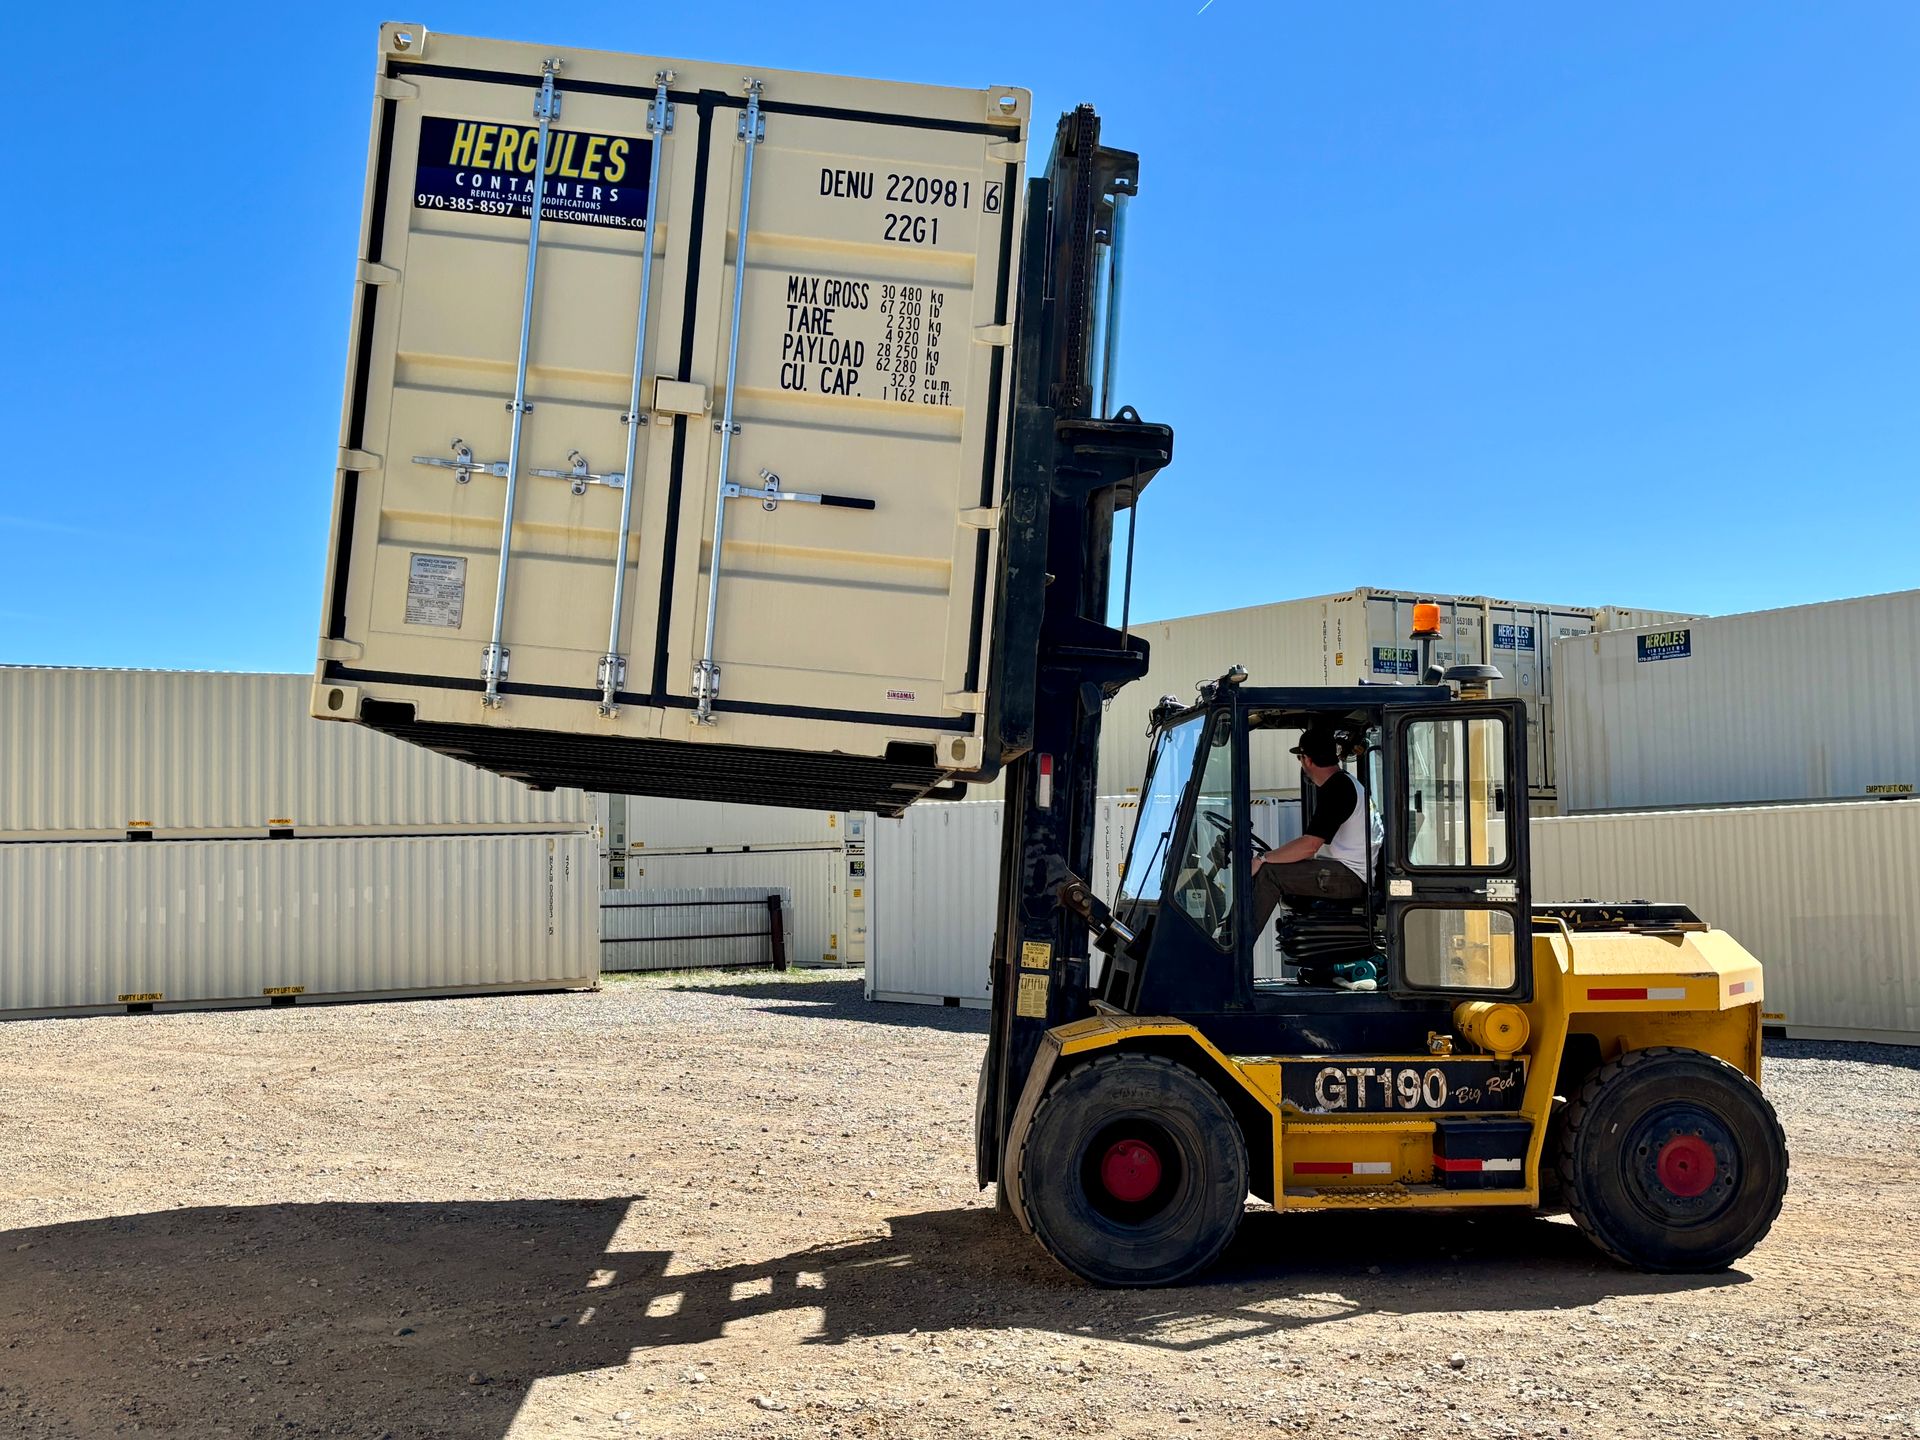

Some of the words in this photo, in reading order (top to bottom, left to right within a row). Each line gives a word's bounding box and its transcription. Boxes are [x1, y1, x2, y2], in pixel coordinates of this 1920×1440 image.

[449, 122, 629, 183] HERCULES
[455, 172, 619, 202] CONTAINERS
[470, 189, 501, 199] RENTAL
[507, 193, 532, 203] SALES
[820, 168, 874, 200] DENU
[886, 174, 970, 209] 220981
[985, 184, 999, 211] 6
[418, 193, 514, 215] 970-385-8597
[522, 205, 648, 228] HCULESCONTAINERS.CO
[884, 213, 939, 244] 22G1
[787, 275, 820, 305] MAX
[823, 279, 870, 310] GROSS
[881, 285, 896, 300] 30
[900, 287, 922, 302] 480
[930, 289, 944, 308] kg
[786, 304, 836, 336] TARE
[886, 315, 894, 329] 2
[898, 316, 920, 331] 230
[928, 319, 942, 337] kg
[880, 300, 894, 314] 67
[898, 302, 921, 316] 200
[930, 305, 940, 318] lb
[782, 333, 865, 368] PAYLOAD
[877, 343, 891, 357] 28
[895, 345, 918, 359] 250
[926, 348, 939, 365] kg
[885, 329, 893, 343] 4
[897, 330, 919, 345] 920
[927, 333, 938, 347] lb
[780, 362, 807, 391] CU.
[820, 367, 861, 397] CAP.
[890, 373, 916, 389] 32.9
[876, 357, 890, 372] 62
[895, 359, 917, 374] 280
[925, 362, 935, 376] lb
[894, 388, 915, 403] 162
[1498, 625, 1529, 639] HERCLES
[1379, 648, 1413, 662] HERCLES
[1866, 785, 1886, 793] EMPTY
[1899, 784, 1913, 793] ONLY
[263, 987, 280, 995] EMPTY
[292, 986, 305, 994] ONLY
[1314, 1066, 1448, 1109] GT190
